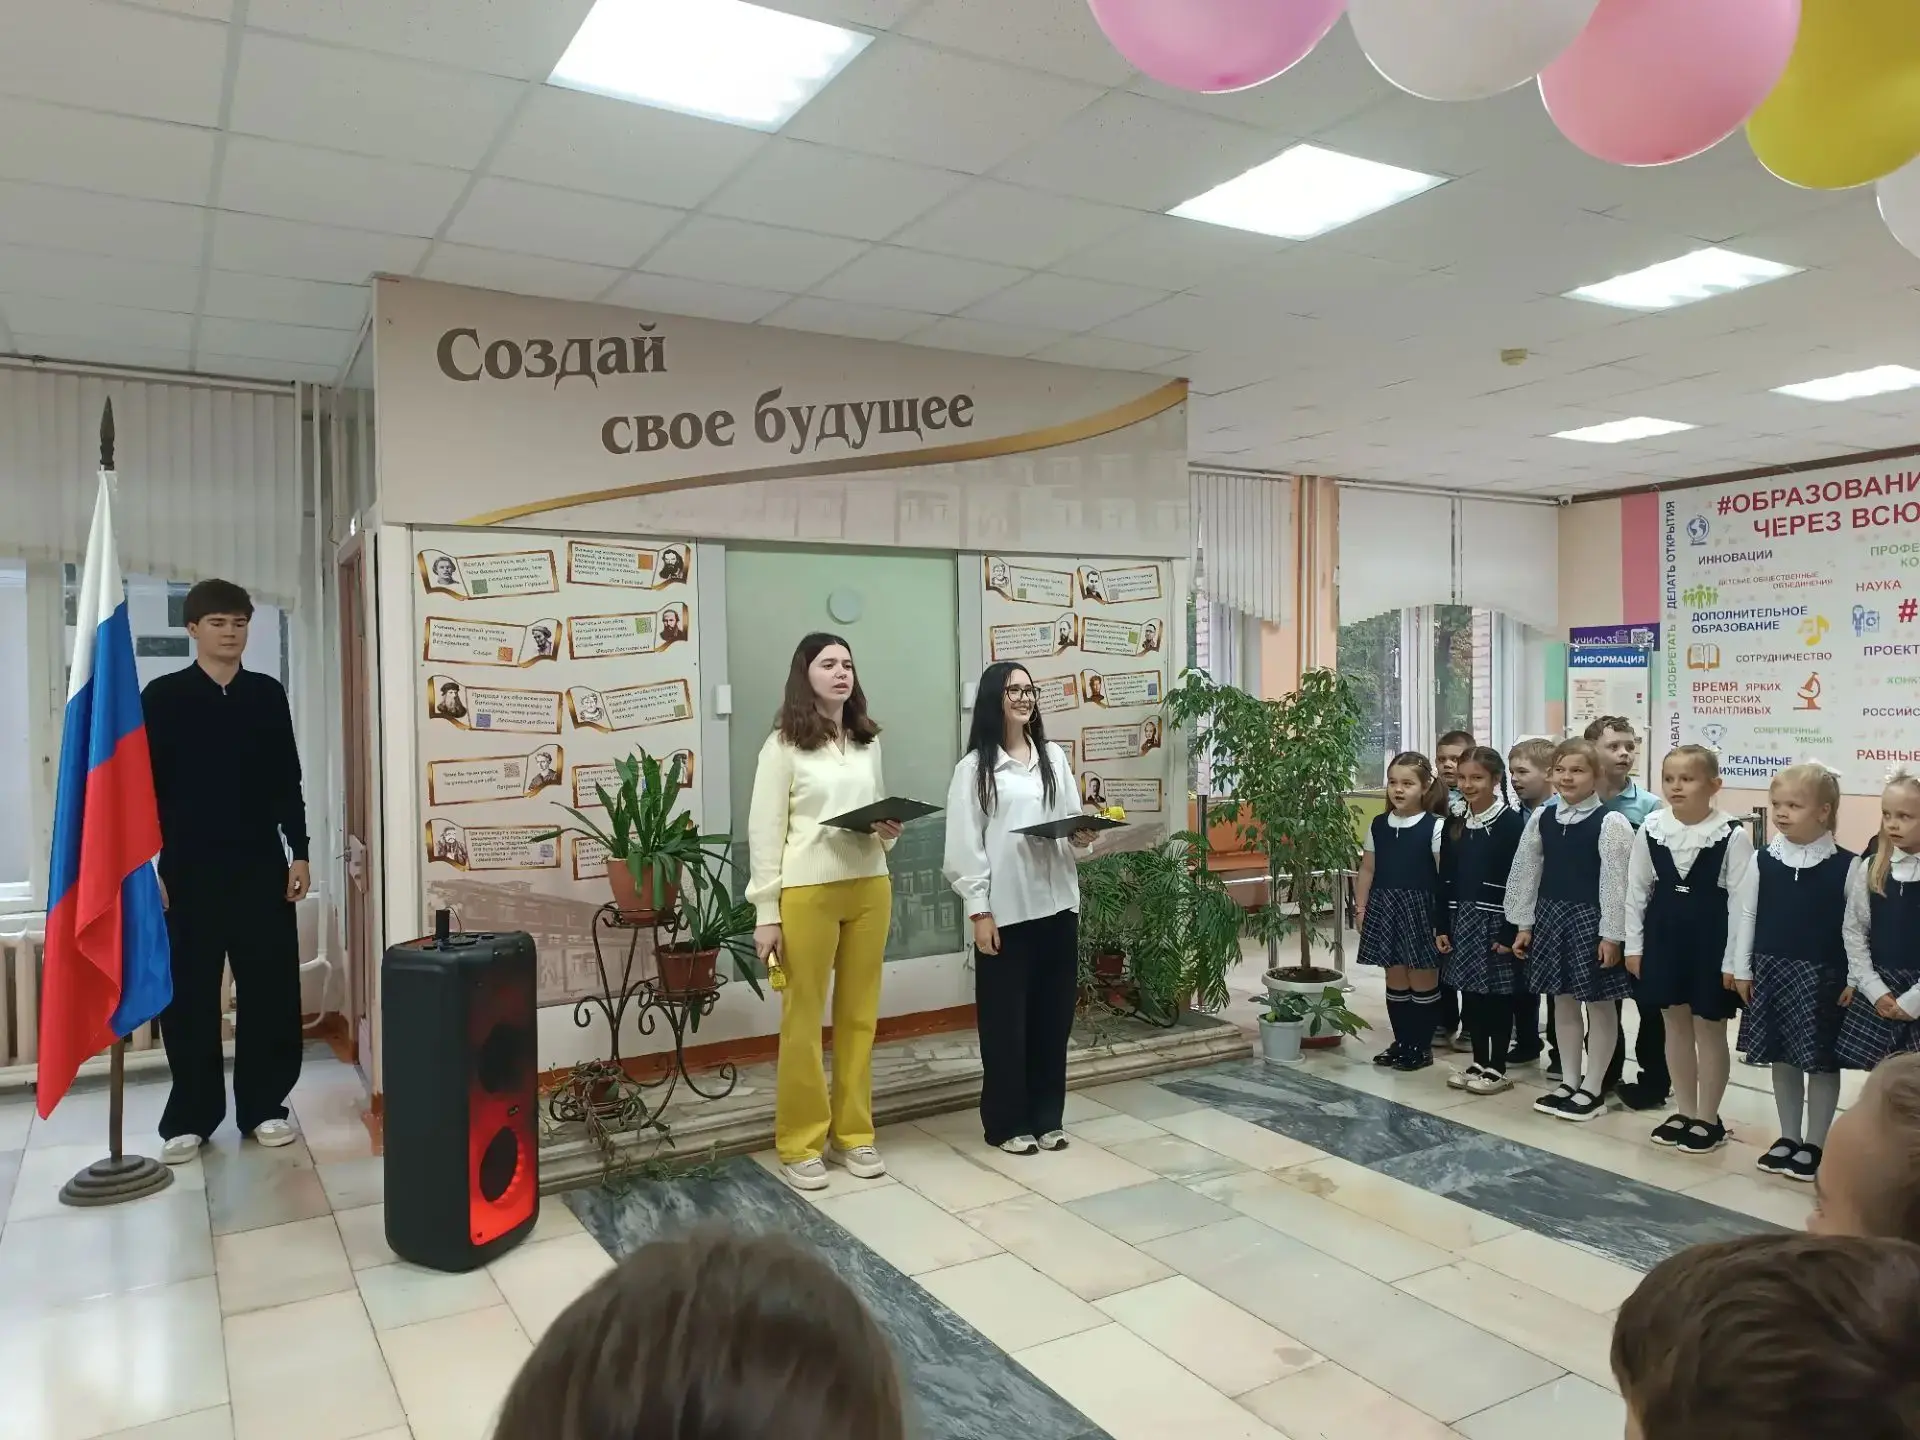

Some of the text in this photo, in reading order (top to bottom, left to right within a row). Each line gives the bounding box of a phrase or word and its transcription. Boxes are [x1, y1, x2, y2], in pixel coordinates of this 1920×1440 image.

[436, 321, 668, 390] Создай
[601, 386, 974, 455] свое будущее
[1754, 501, 1920, 539] ЧЕРЕЗ ВСЮ
[1666, 500, 1676, 609] ДЕЛАТЬ ОТКРЫТИЯ
[1870, 543, 1920, 557] ПРОФЕ
[1698, 550, 1773, 566] ИННОВАЦИИ
[1856, 580, 1902, 592] НАУКА
[1692, 606, 1808, 622] ДОПОЛНИТЕЛЬНОЕ
[1692, 621, 1780, 634] ОБРАЗОВАНИЕ
[1863, 644, 1920, 656] ПРОЕКТ
[1573, 655, 1645, 665] ИНФОРМАЦИЯ
[1668, 624, 1677, 697] ИЗОБРЕТАТЬ
[1736, 652, 1832, 664] СОТРУДНИЧЕСТВО
[1692, 681, 1781, 692] ВРЕМЯ ЯРКИХ
[1692, 695, 1761, 704] ТВОРЧЕСКИХ
[1692, 706, 1772, 715] ТАЛАНТЛИВЫХ
[1862, 705, 1920, 717] РОССИЙС
[1670, 711, 1680, 751] АВАТЬ
[1728, 755, 1792, 766] РЕАЛЬНЫЕ
[1856, 749, 1920, 761] РАВНЫЕ
